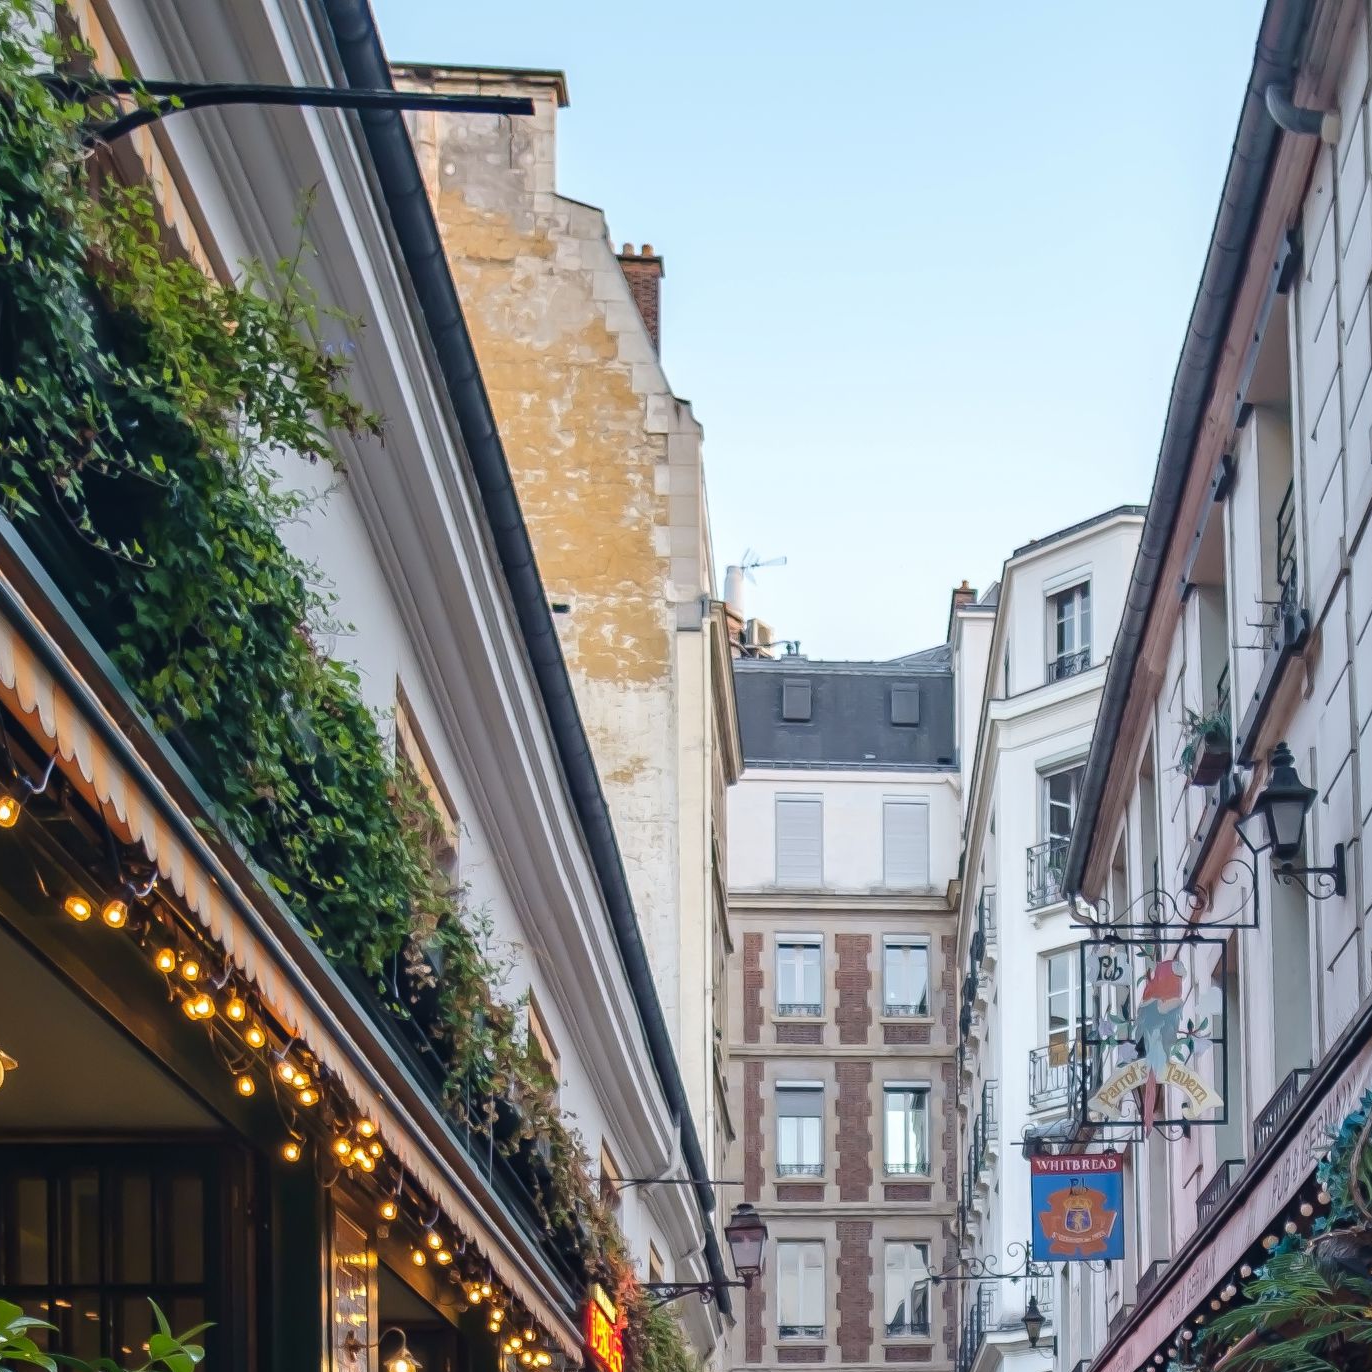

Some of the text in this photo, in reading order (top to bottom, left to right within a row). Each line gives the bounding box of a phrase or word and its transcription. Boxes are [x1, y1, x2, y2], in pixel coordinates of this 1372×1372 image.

[1096, 955, 1124, 982] Pub
[1097, 1063, 1208, 1109] Parrot's Tavern
[1036, 1158, 1117, 1171] WHITBREAD
